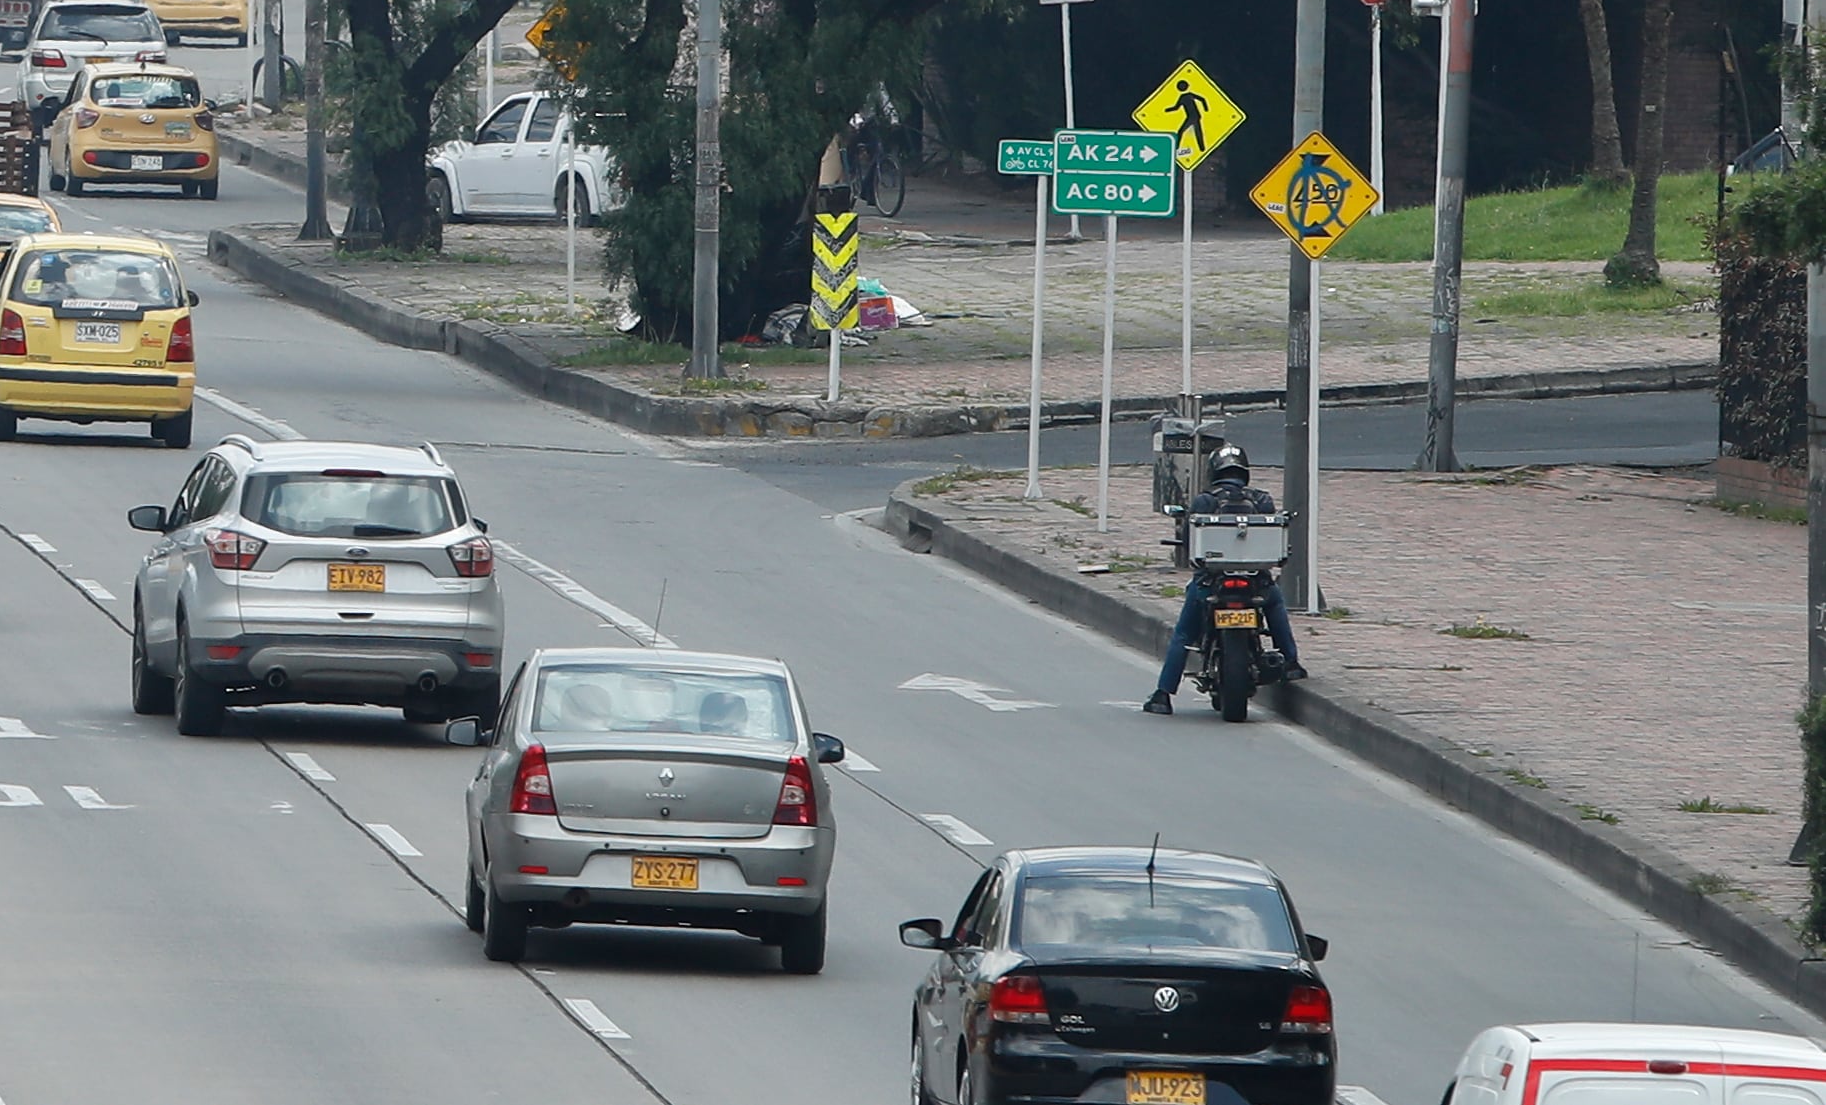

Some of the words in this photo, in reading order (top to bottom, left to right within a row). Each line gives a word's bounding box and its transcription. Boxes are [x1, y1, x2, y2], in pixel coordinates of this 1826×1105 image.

[1017, 146, 1032, 156] AV
[1034, 147, 1047, 157] CL
[1067, 143, 1099, 161] AK
[1104, 144, 1134, 162] 24
[1027, 159, 1041, 169] CL
[1066, 182, 1098, 200] AC
[1104, 184, 1134, 202] 80
[1060, 1015, 1086, 1024] GOL
